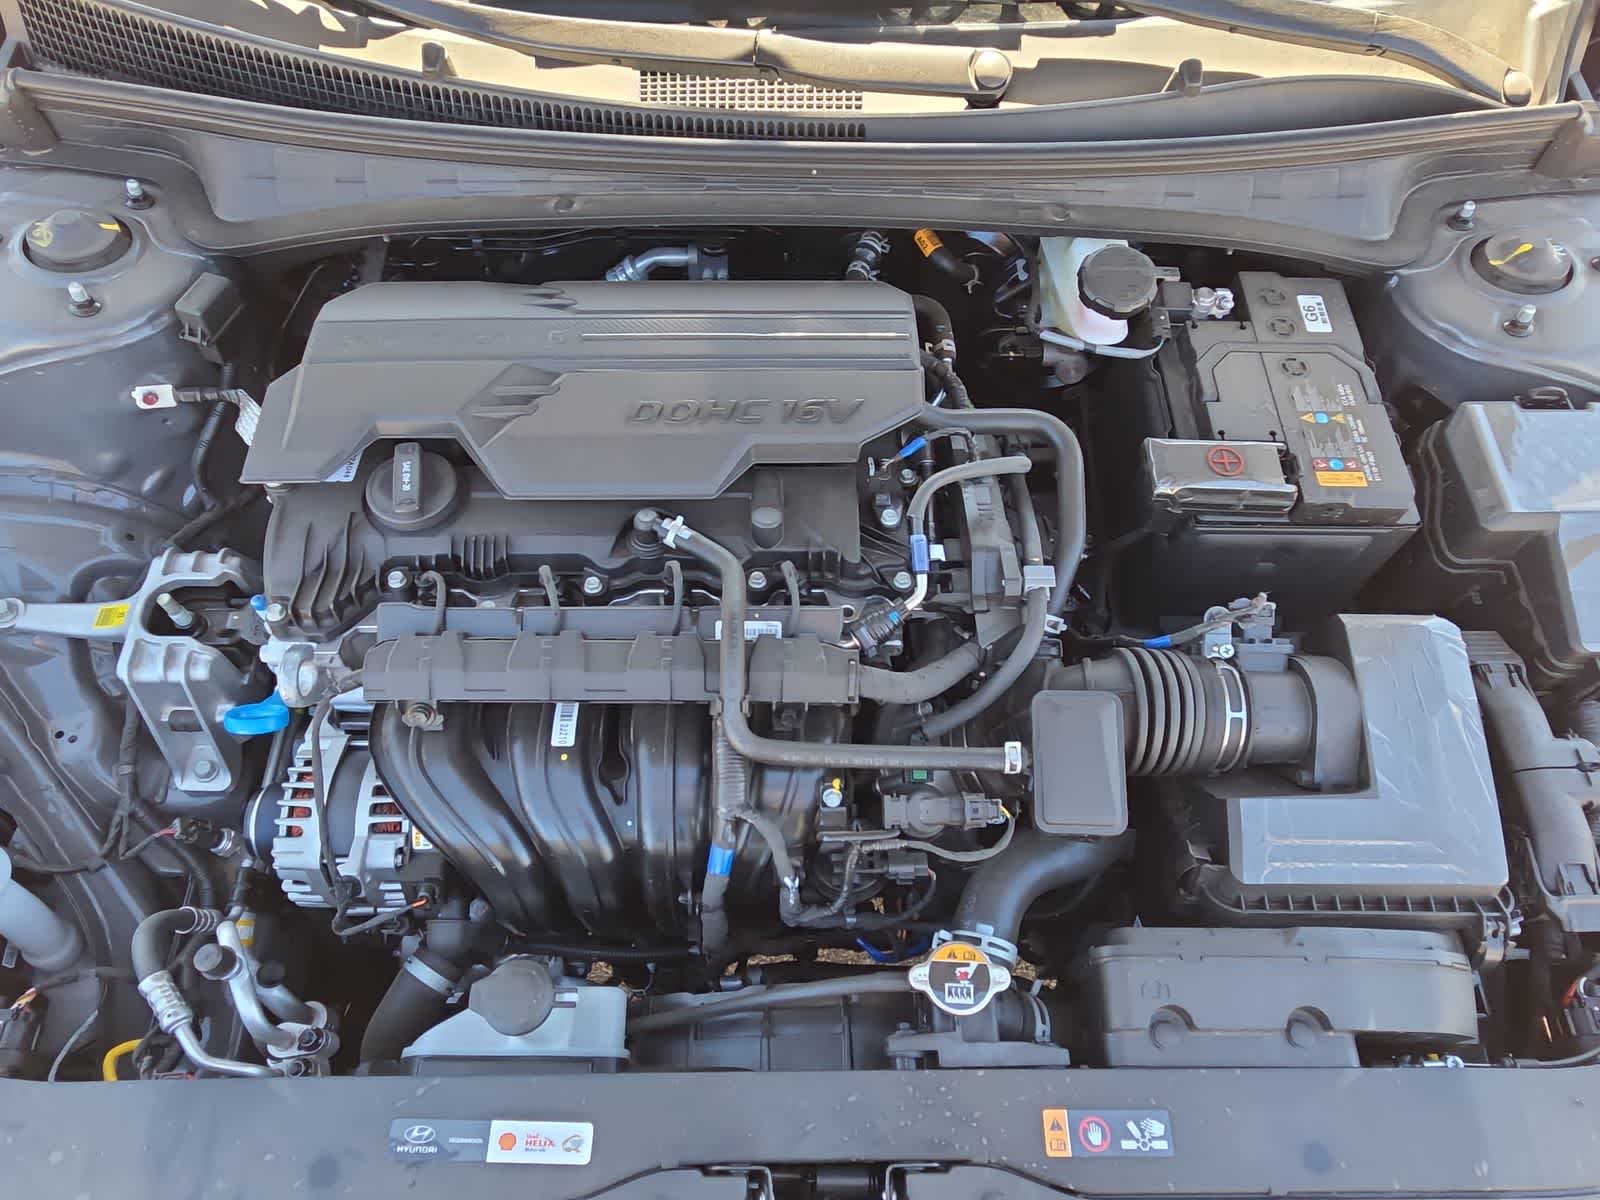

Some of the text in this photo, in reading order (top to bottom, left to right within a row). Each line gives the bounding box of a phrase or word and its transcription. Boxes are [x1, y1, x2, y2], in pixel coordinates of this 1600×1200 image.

[1303, 305, 1319, 322] G6
[629, 398, 865, 424] DOHC 16V
[525, 1137, 556, 1147] HELIX
[396, 1145, 438, 1154] HYUNDAI
